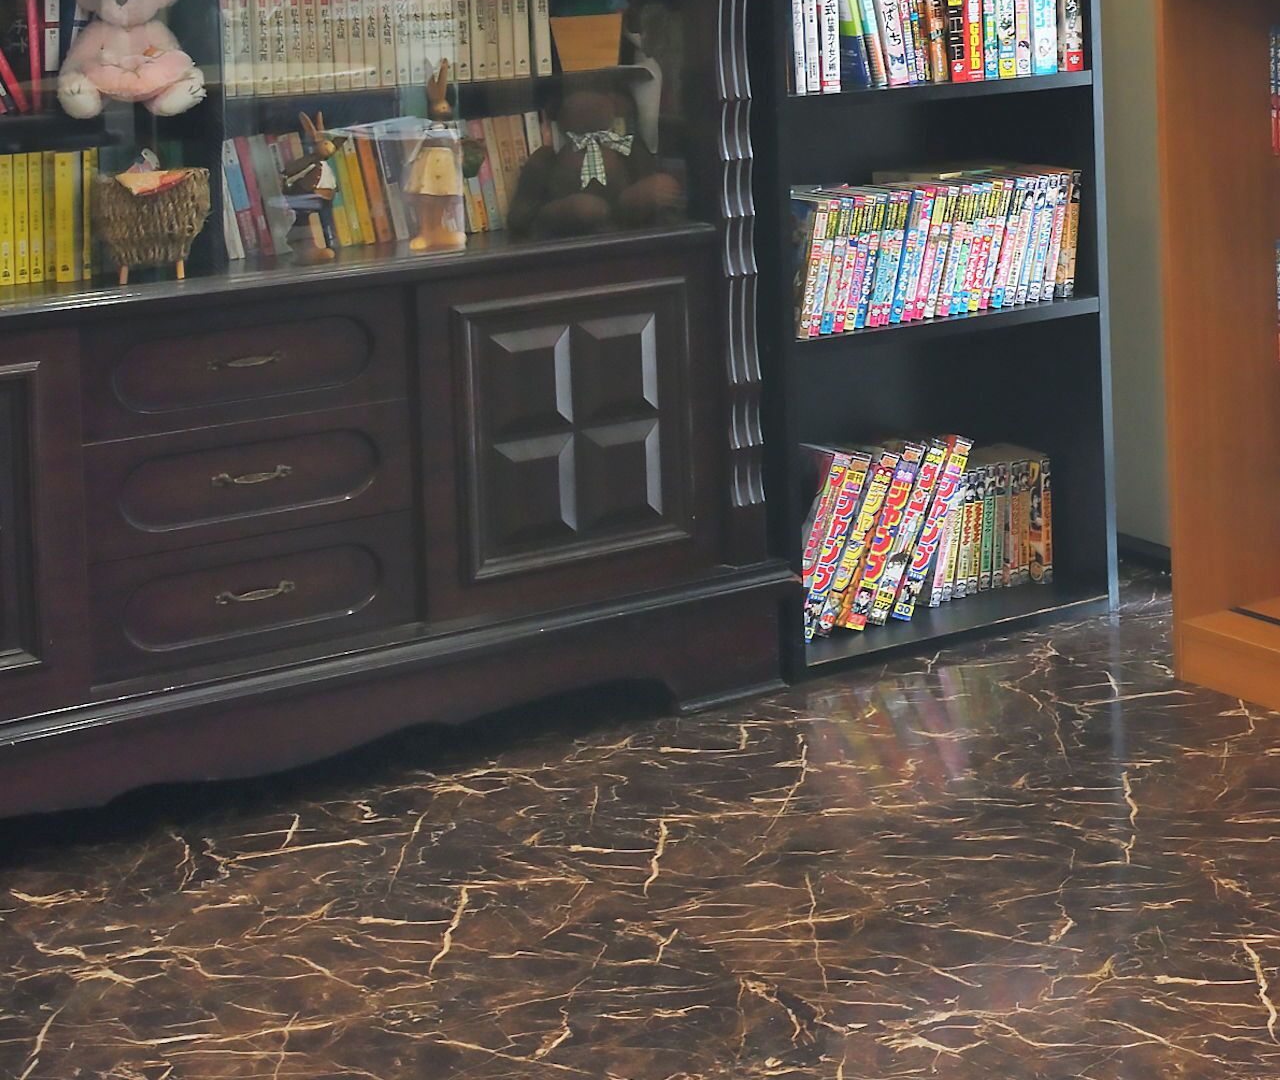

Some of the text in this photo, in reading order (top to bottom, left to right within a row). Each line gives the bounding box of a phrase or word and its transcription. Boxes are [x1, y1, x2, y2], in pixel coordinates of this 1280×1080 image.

[970, 24, 980, 69] GOLD
[859, 256, 876, 304] ドラえもん
[897, 604, 910, 613] 30
